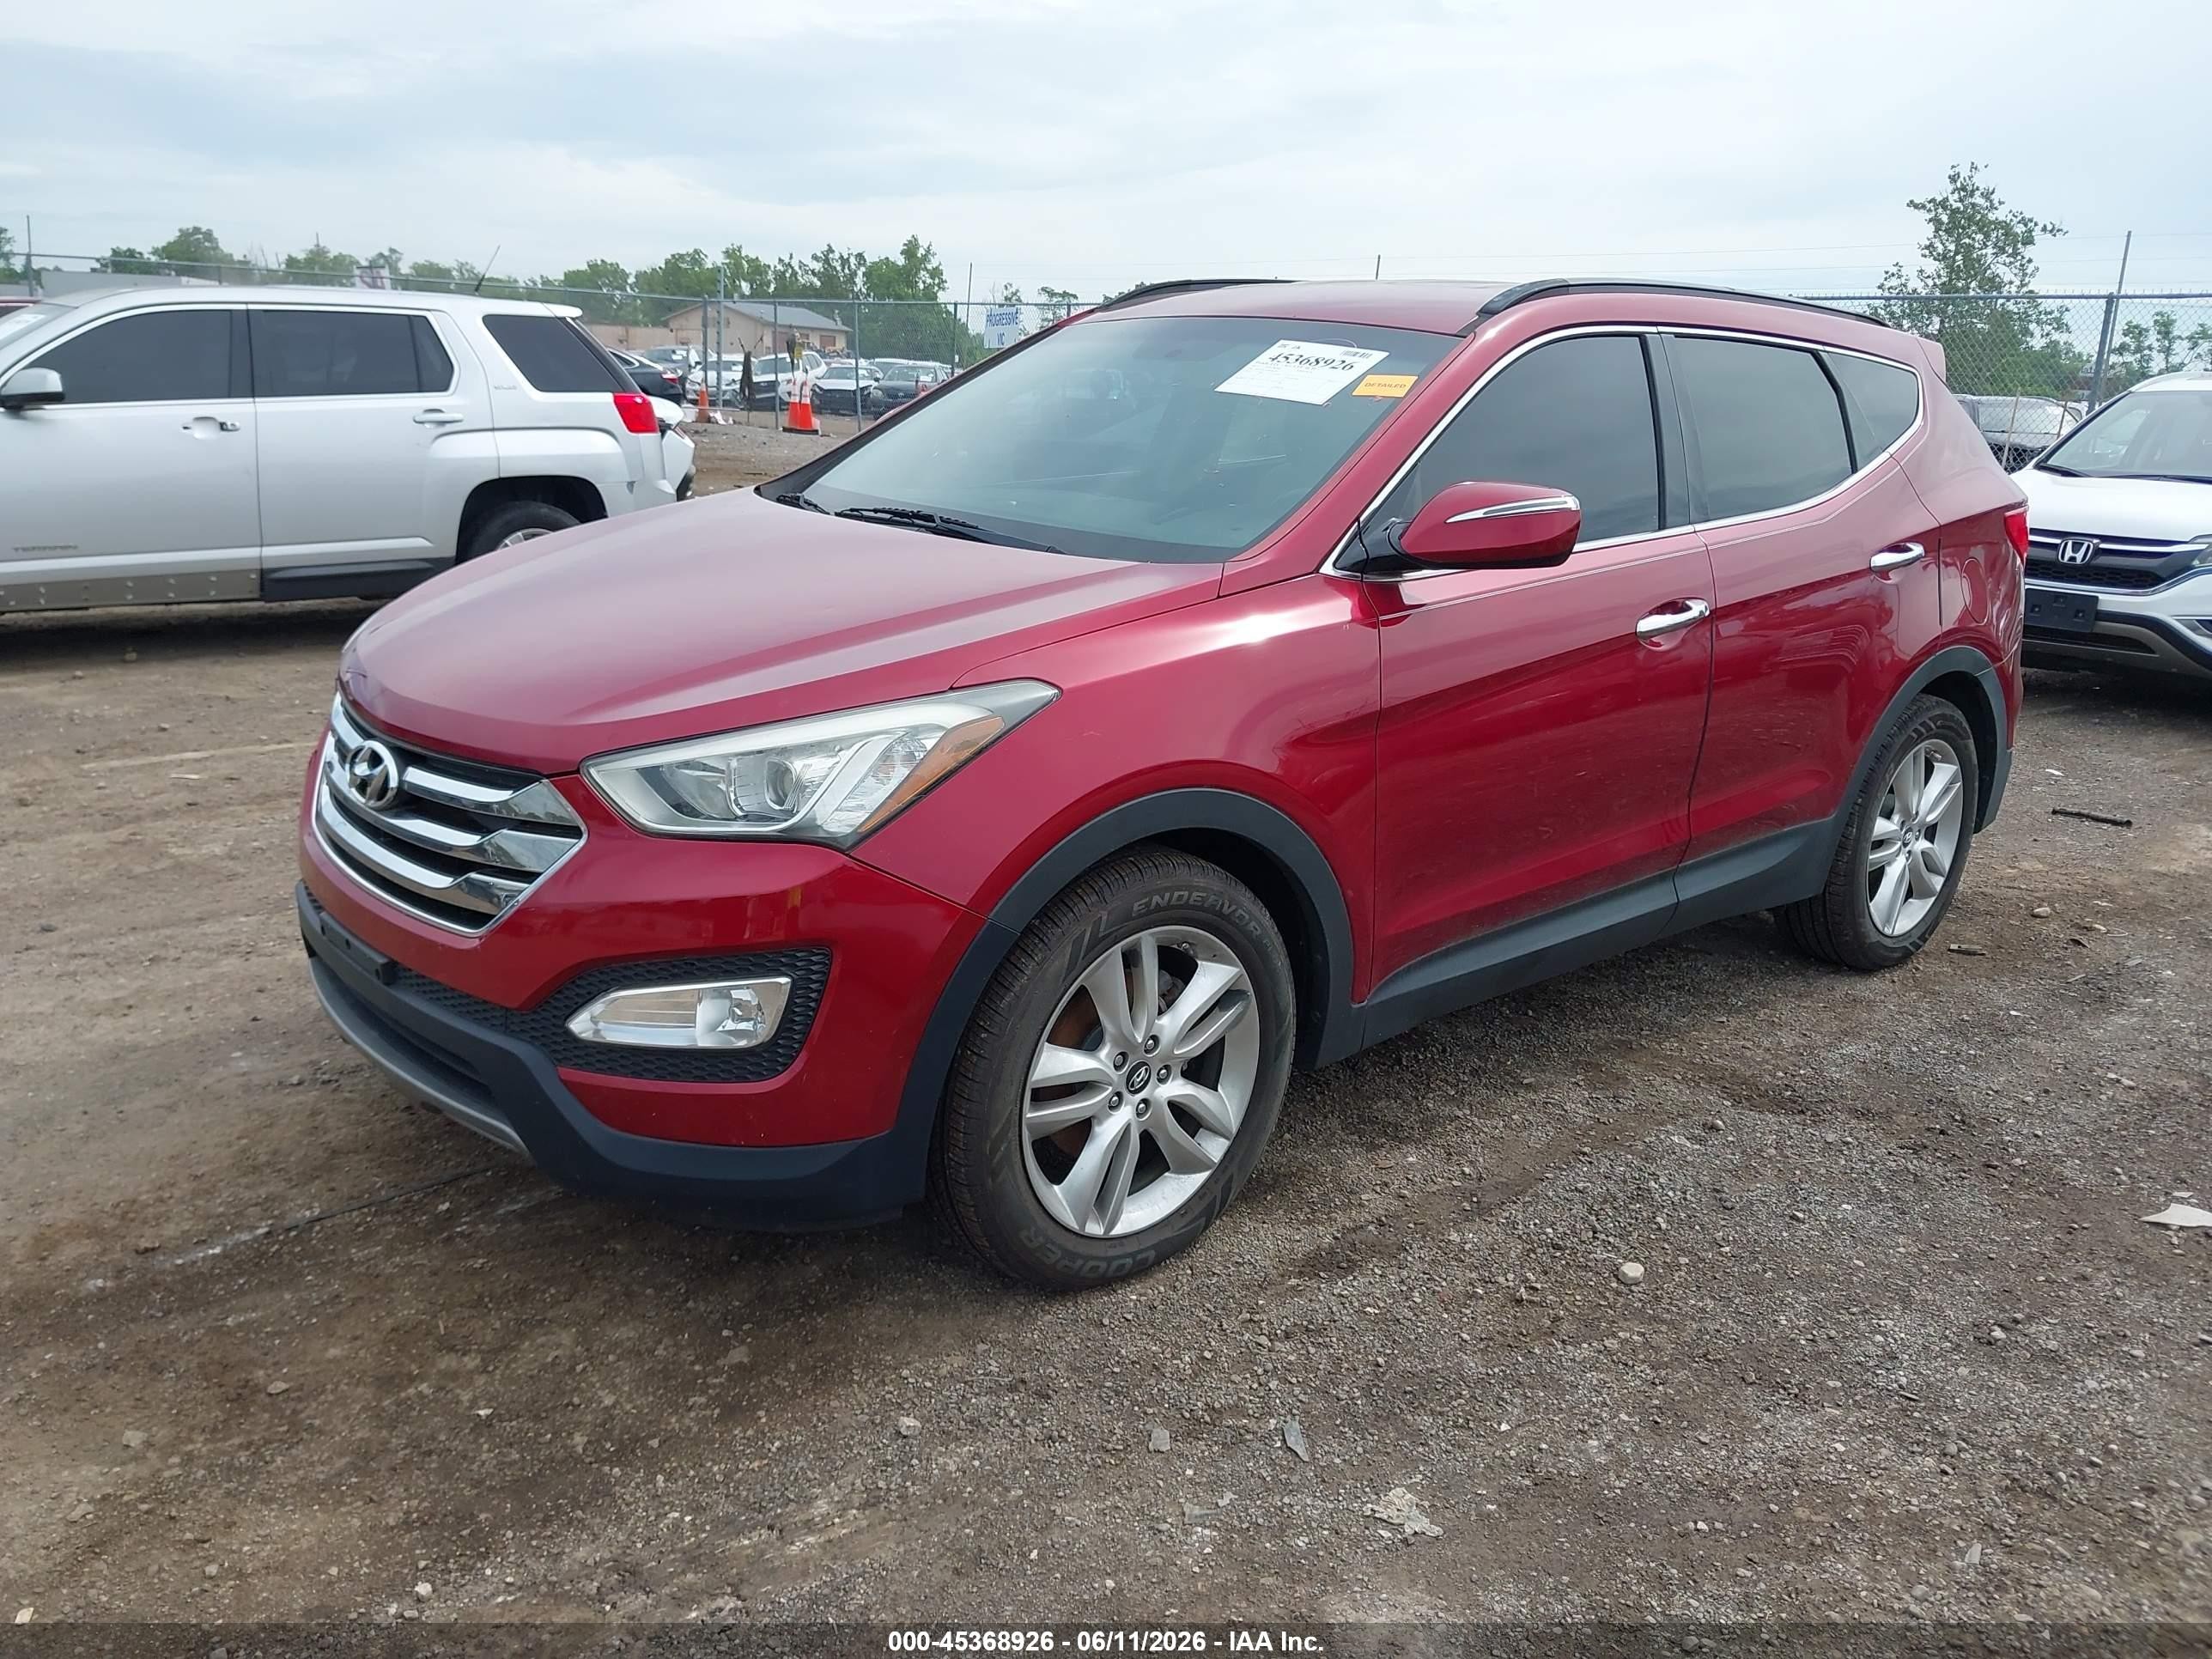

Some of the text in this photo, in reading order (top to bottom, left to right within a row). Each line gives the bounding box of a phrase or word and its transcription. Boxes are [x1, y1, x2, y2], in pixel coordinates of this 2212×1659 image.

[987, 312, 1018, 327] PROGRESSIVE
[1267, 352, 1360, 372] 45368926
[1364, 380, 1407, 389] DETAILED
[1132, 890, 1261, 940] ENDEAVOR
[1018, 1227, 1157, 1279] COOPER
